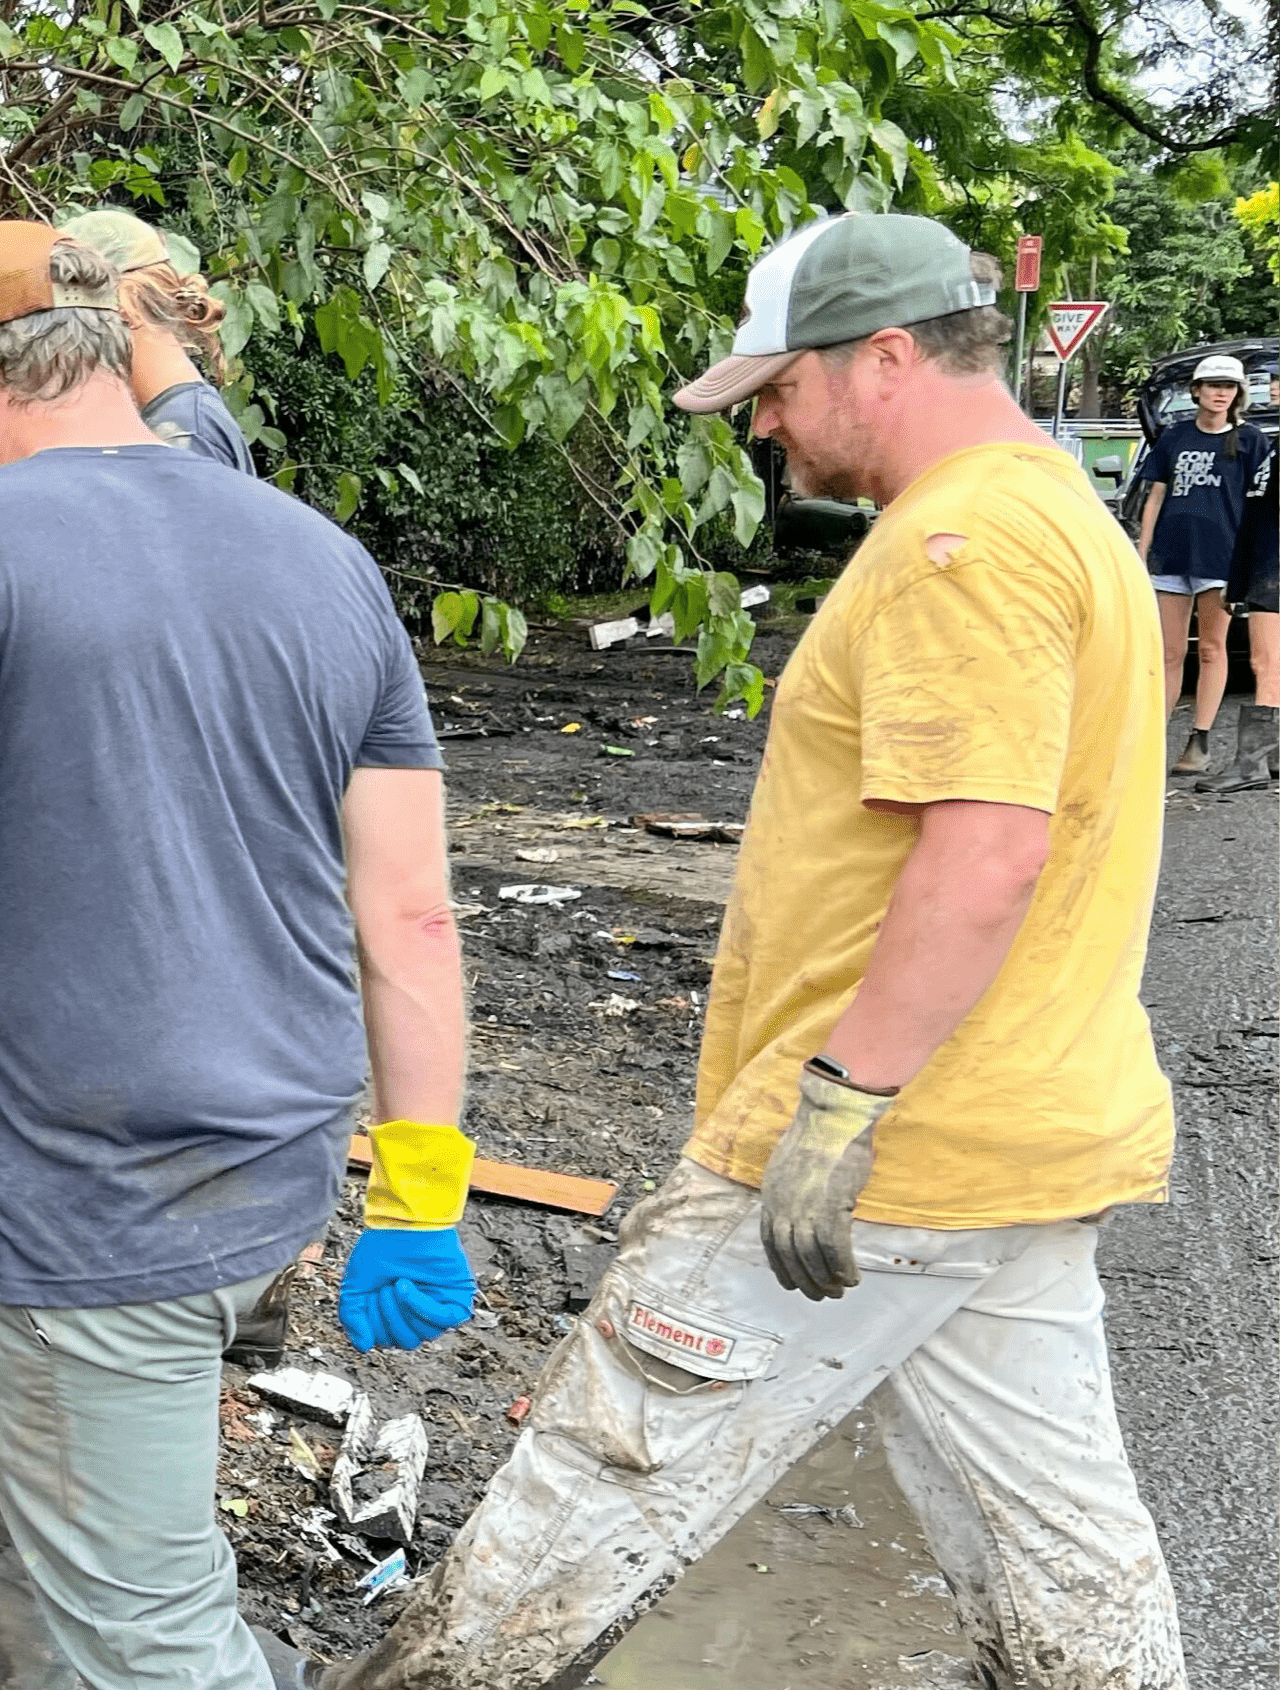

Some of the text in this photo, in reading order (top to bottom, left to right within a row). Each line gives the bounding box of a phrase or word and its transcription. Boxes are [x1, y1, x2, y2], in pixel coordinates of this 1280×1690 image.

[1053, 312, 1085, 323] GIVE
[1178, 451, 1216, 463] CON
[1174, 462, 1214, 474] SURF
[1174, 474, 1222, 487] ATION
[633, 1307, 703, 1350] Element
